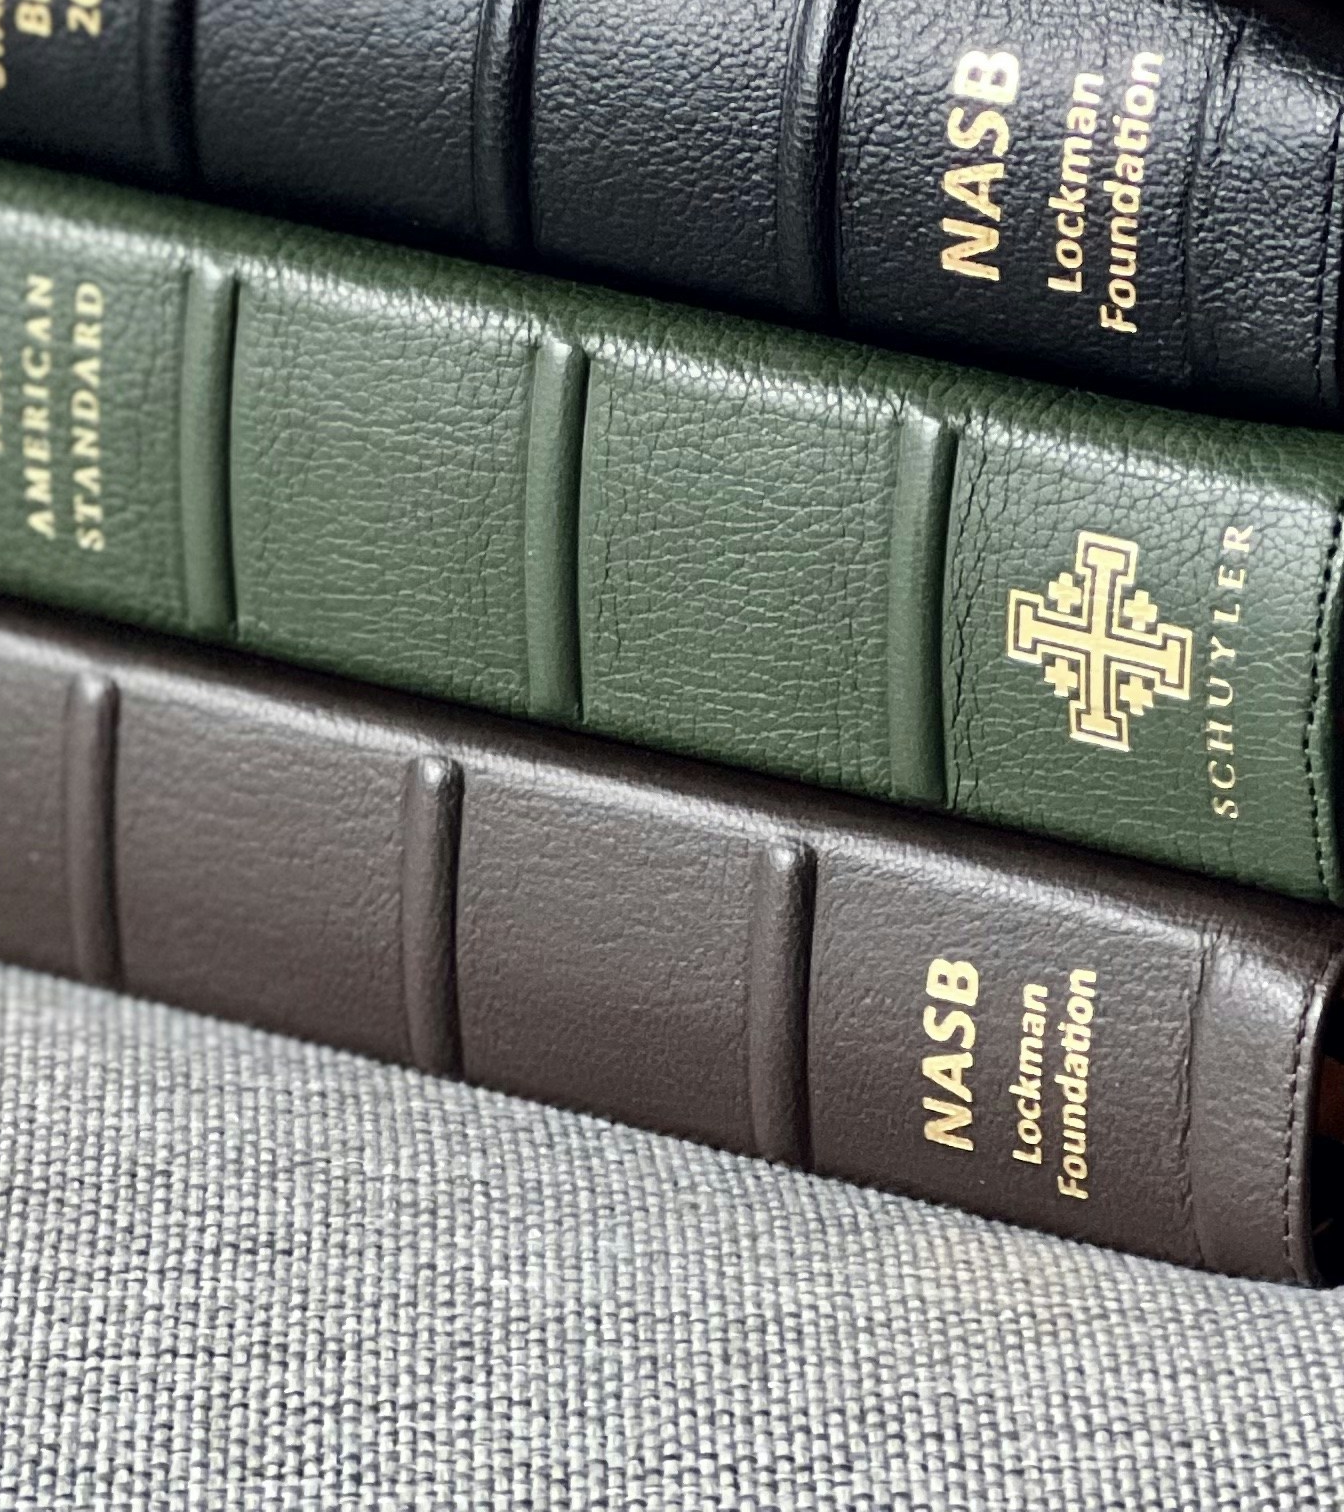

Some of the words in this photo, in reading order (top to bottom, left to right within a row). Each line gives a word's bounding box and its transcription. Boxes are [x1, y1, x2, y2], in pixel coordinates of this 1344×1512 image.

[940, 49, 1020, 282] NASB
[1047, 71, 1105, 293] Lockman
[1099, 51, 1164, 334] Foundation
[22, 274, 57, 541] AMERICAN
[71, 283, 105, 552] STANDARD
[1207, 524, 1254, 820] SCHUYLER
[922, 958, 980, 1152] NASB
[1008, 983, 1049, 1165] Lockman
[1054, 968, 1098, 1200] Foundation
